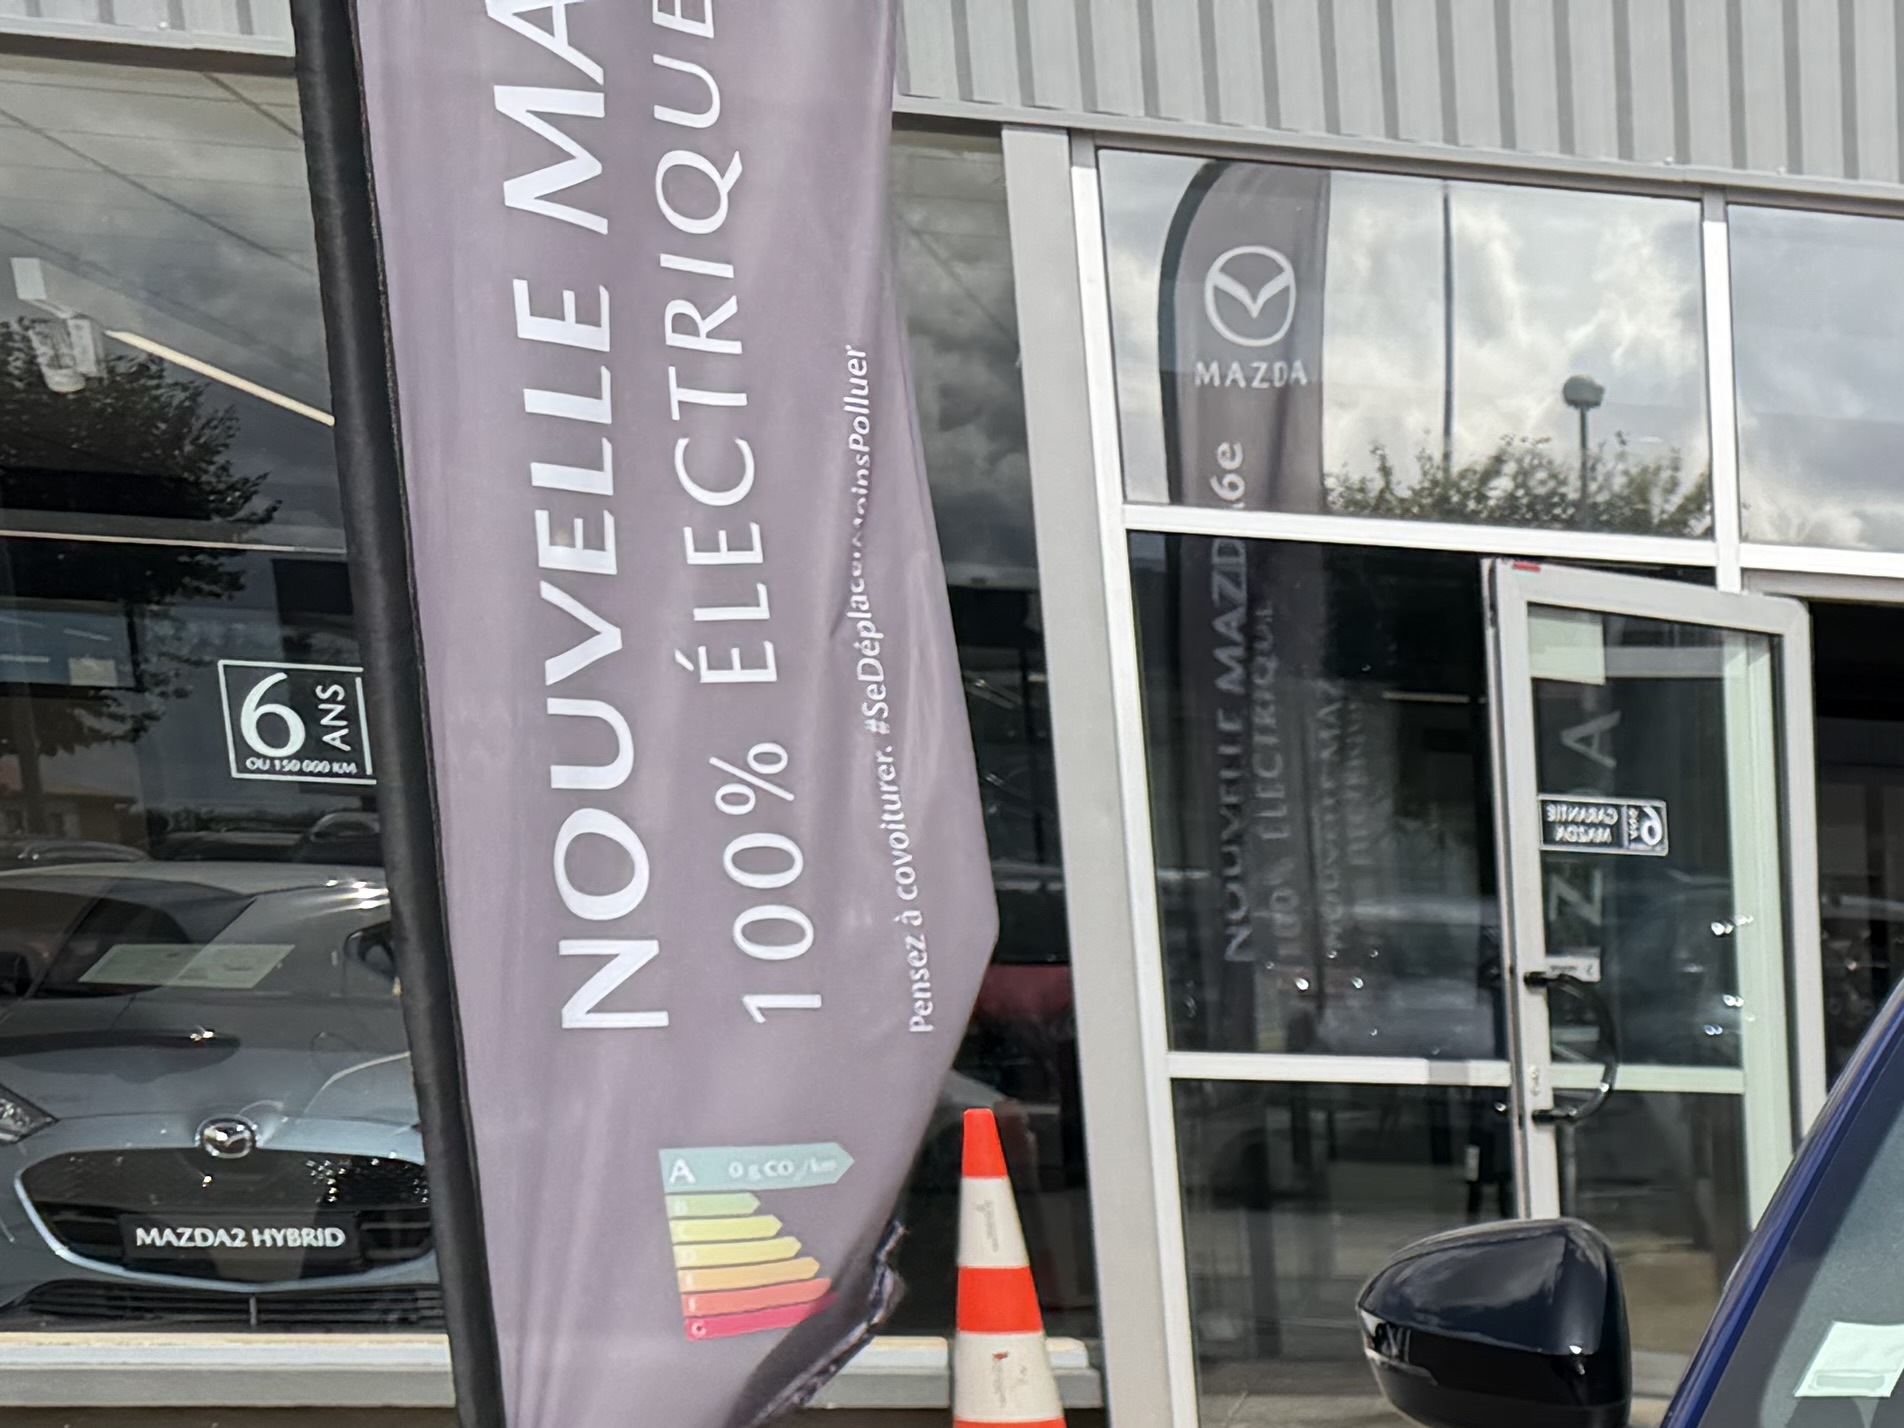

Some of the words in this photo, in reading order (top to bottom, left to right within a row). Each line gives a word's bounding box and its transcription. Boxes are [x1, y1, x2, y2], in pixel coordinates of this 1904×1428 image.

[652, 0, 779, 685] ÉLECTRIQUE
[1194, 359, 1308, 390] MAZDA
[843, 344, 891, 735] #SeDéplacinsPolluer
[1209, 441, 1248, 695] MAZD6e
[512, 279, 670, 1029] NOUVELLE
[240, 671, 306, 758] 6
[315, 684, 352, 752] ANS
[246, 757, 270, 771] OU
[875, 745, 919, 902] covoiturer.
[711, 740, 823, 1024] 100%
[893, 909, 925, 927] à
[904, 933, 936, 1033] Pensez
[669, 1157, 697, 1184] A
[135, 1226, 249, 1248] MAZDA2
[251, 1226, 346, 1248] HYBRID
